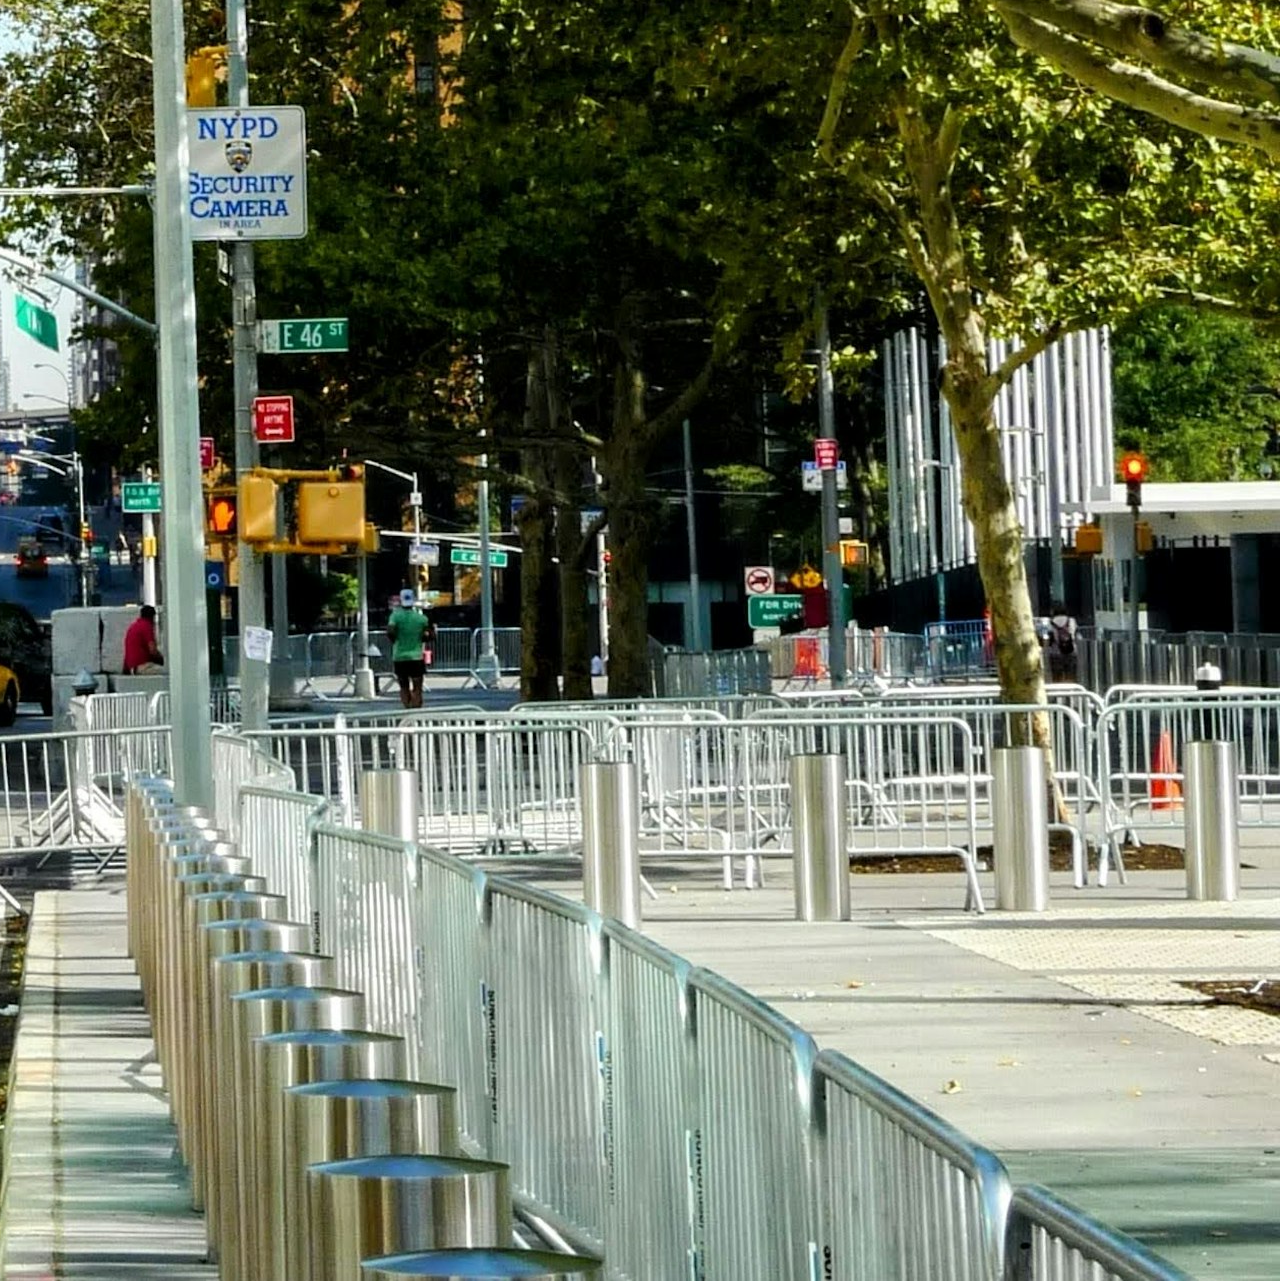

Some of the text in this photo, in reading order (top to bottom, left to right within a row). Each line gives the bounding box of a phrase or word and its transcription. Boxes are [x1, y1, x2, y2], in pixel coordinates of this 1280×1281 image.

[198, 116, 278, 139] NYPD
[189, 172, 294, 194] SECURITY
[190, 196, 289, 218] CAMERA
[220, 219, 261, 229] IN AREA
[284, 323, 344, 348] E 46 ST
[759, 600, 803, 609] FDR Driv
